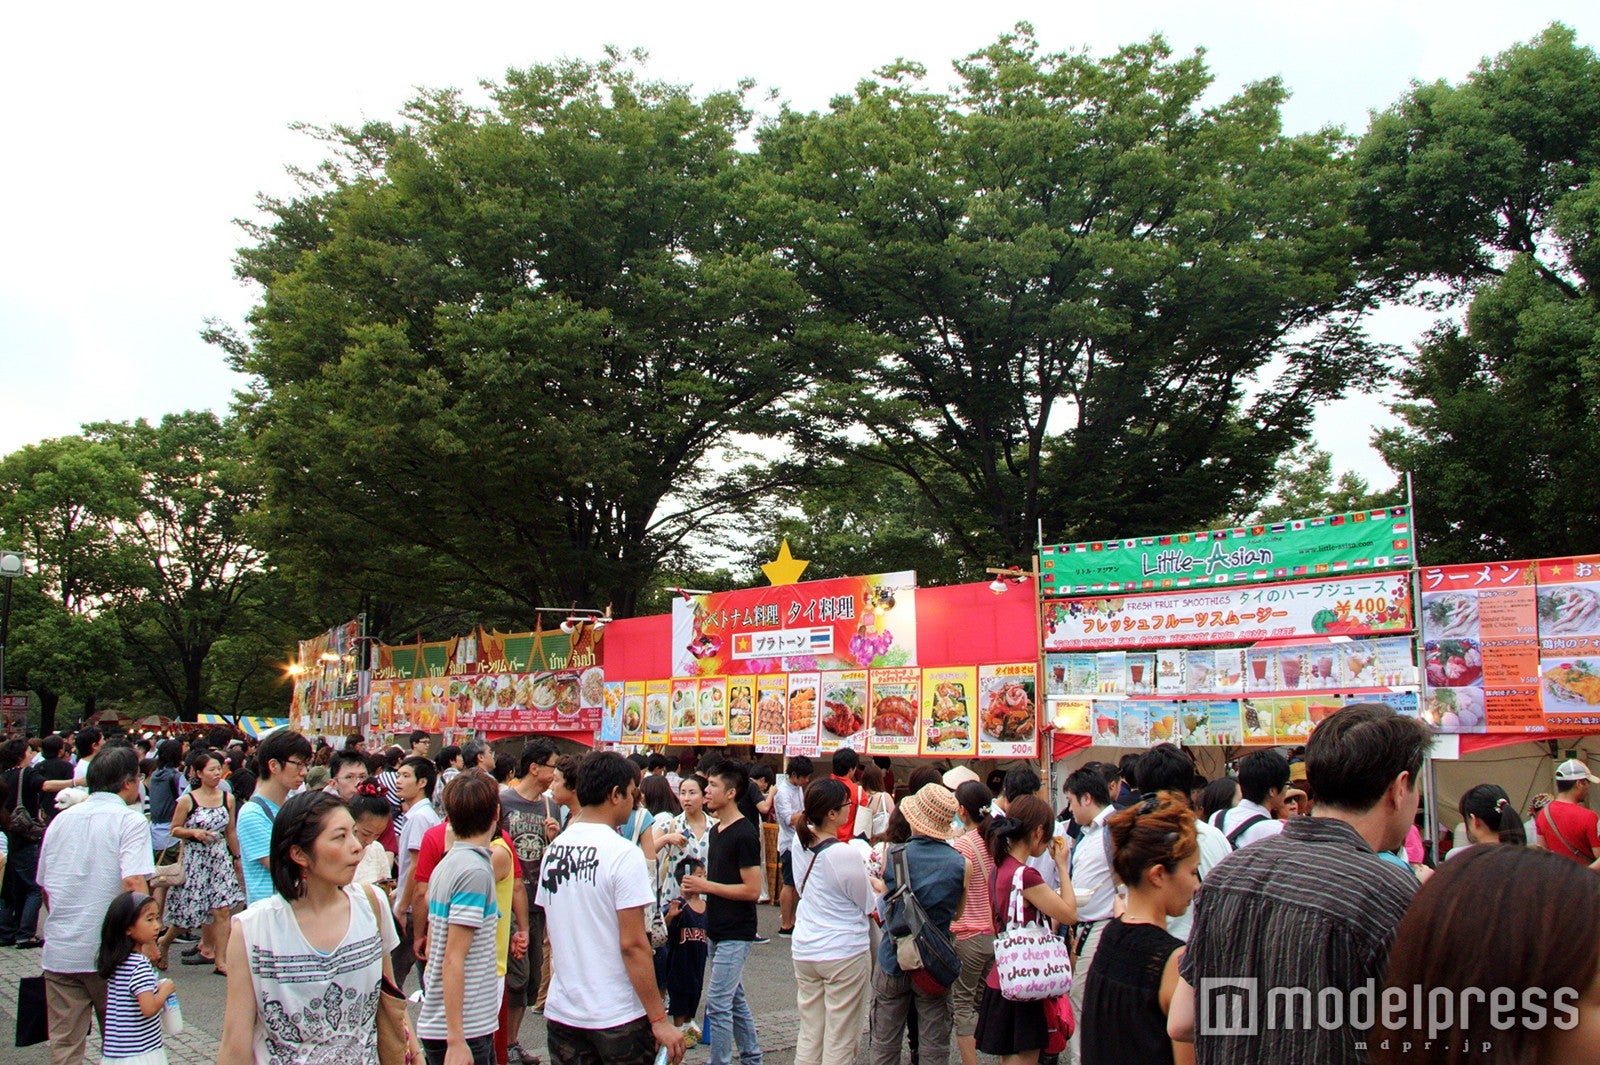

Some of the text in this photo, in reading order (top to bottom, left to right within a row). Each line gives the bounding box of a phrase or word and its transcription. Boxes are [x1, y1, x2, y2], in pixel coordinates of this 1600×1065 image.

[1141, 542, 1273, 576] Little-Asian
[1426, 566, 1520, 589] ラーメン
[1239, 580, 1388, 605] タイのハーブジュース
[706, 595, 855, 630] ベトナム料理 タイ料理
[1127, 596, 1231, 611] FRESH FRUIT SMOOTHIES
[1083, 607, 1288, 634] フレッシュフルーツスムージー
[995, 665, 1035, 676] タイ焼きそば
[1011, 743, 1033, 754] 500円
[1008, 962, 1064, 981] cher cher
[1026, 980, 1049, 993] cher
